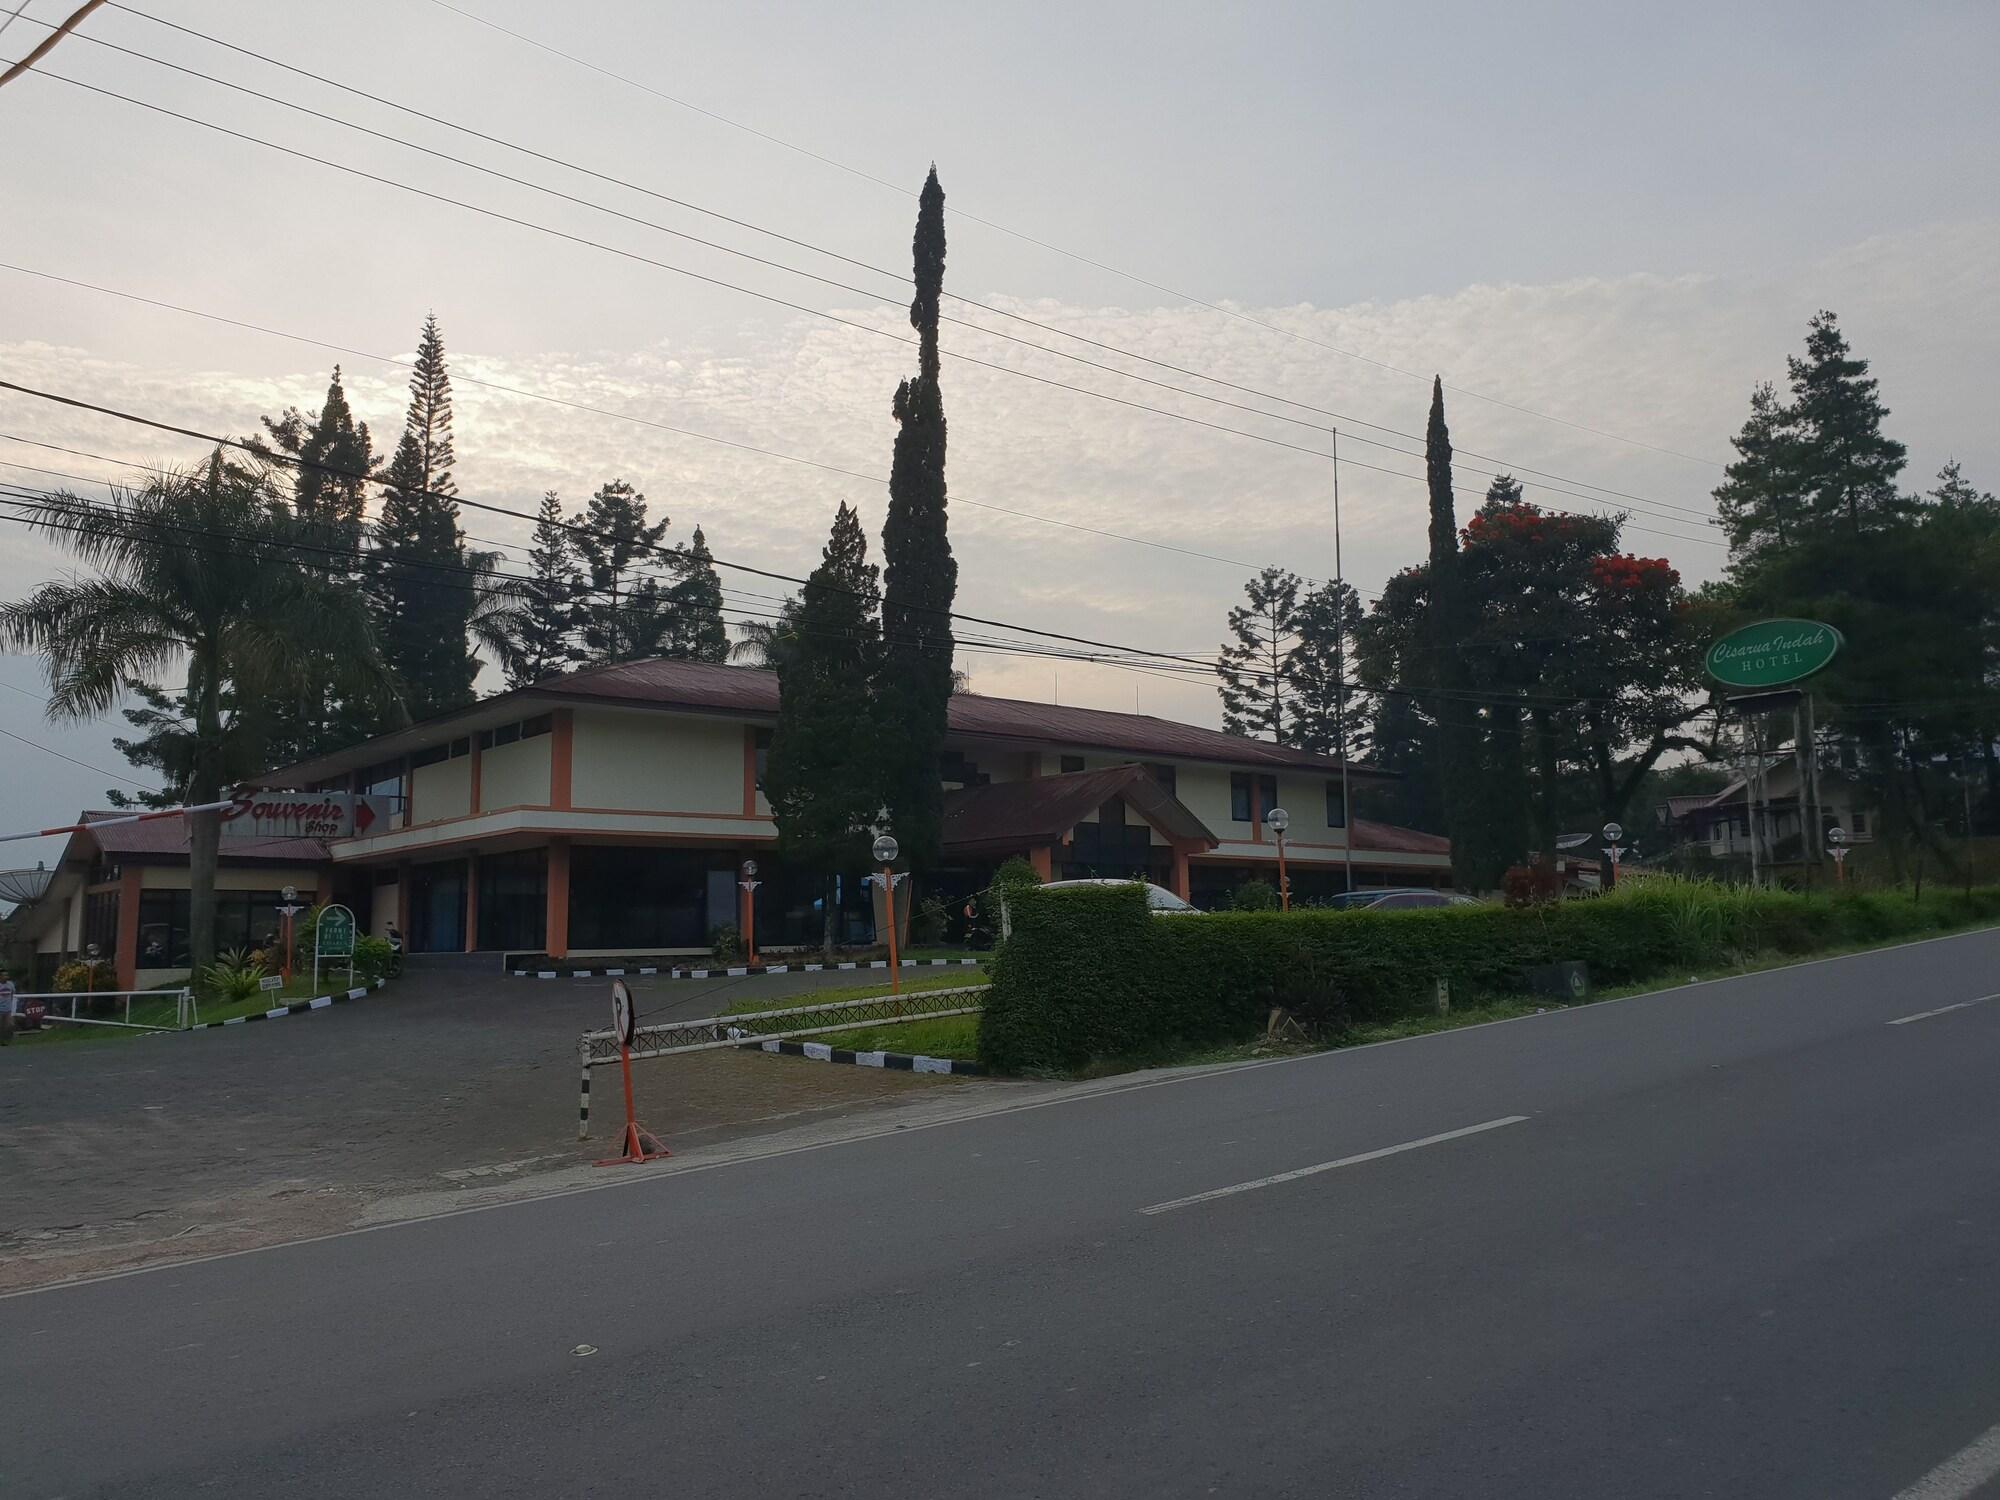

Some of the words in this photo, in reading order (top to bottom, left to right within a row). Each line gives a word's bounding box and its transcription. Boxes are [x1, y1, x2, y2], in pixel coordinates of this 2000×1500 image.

[1713, 643, 1771, 663] Cisarua
[1772, 629, 1825, 651] Indah
[1742, 652, 1803, 672] HOTEL
[219, 788, 344, 822] Souvenir
[305, 820, 338, 835] Shop
[26, 1006, 46, 1015] STOP
